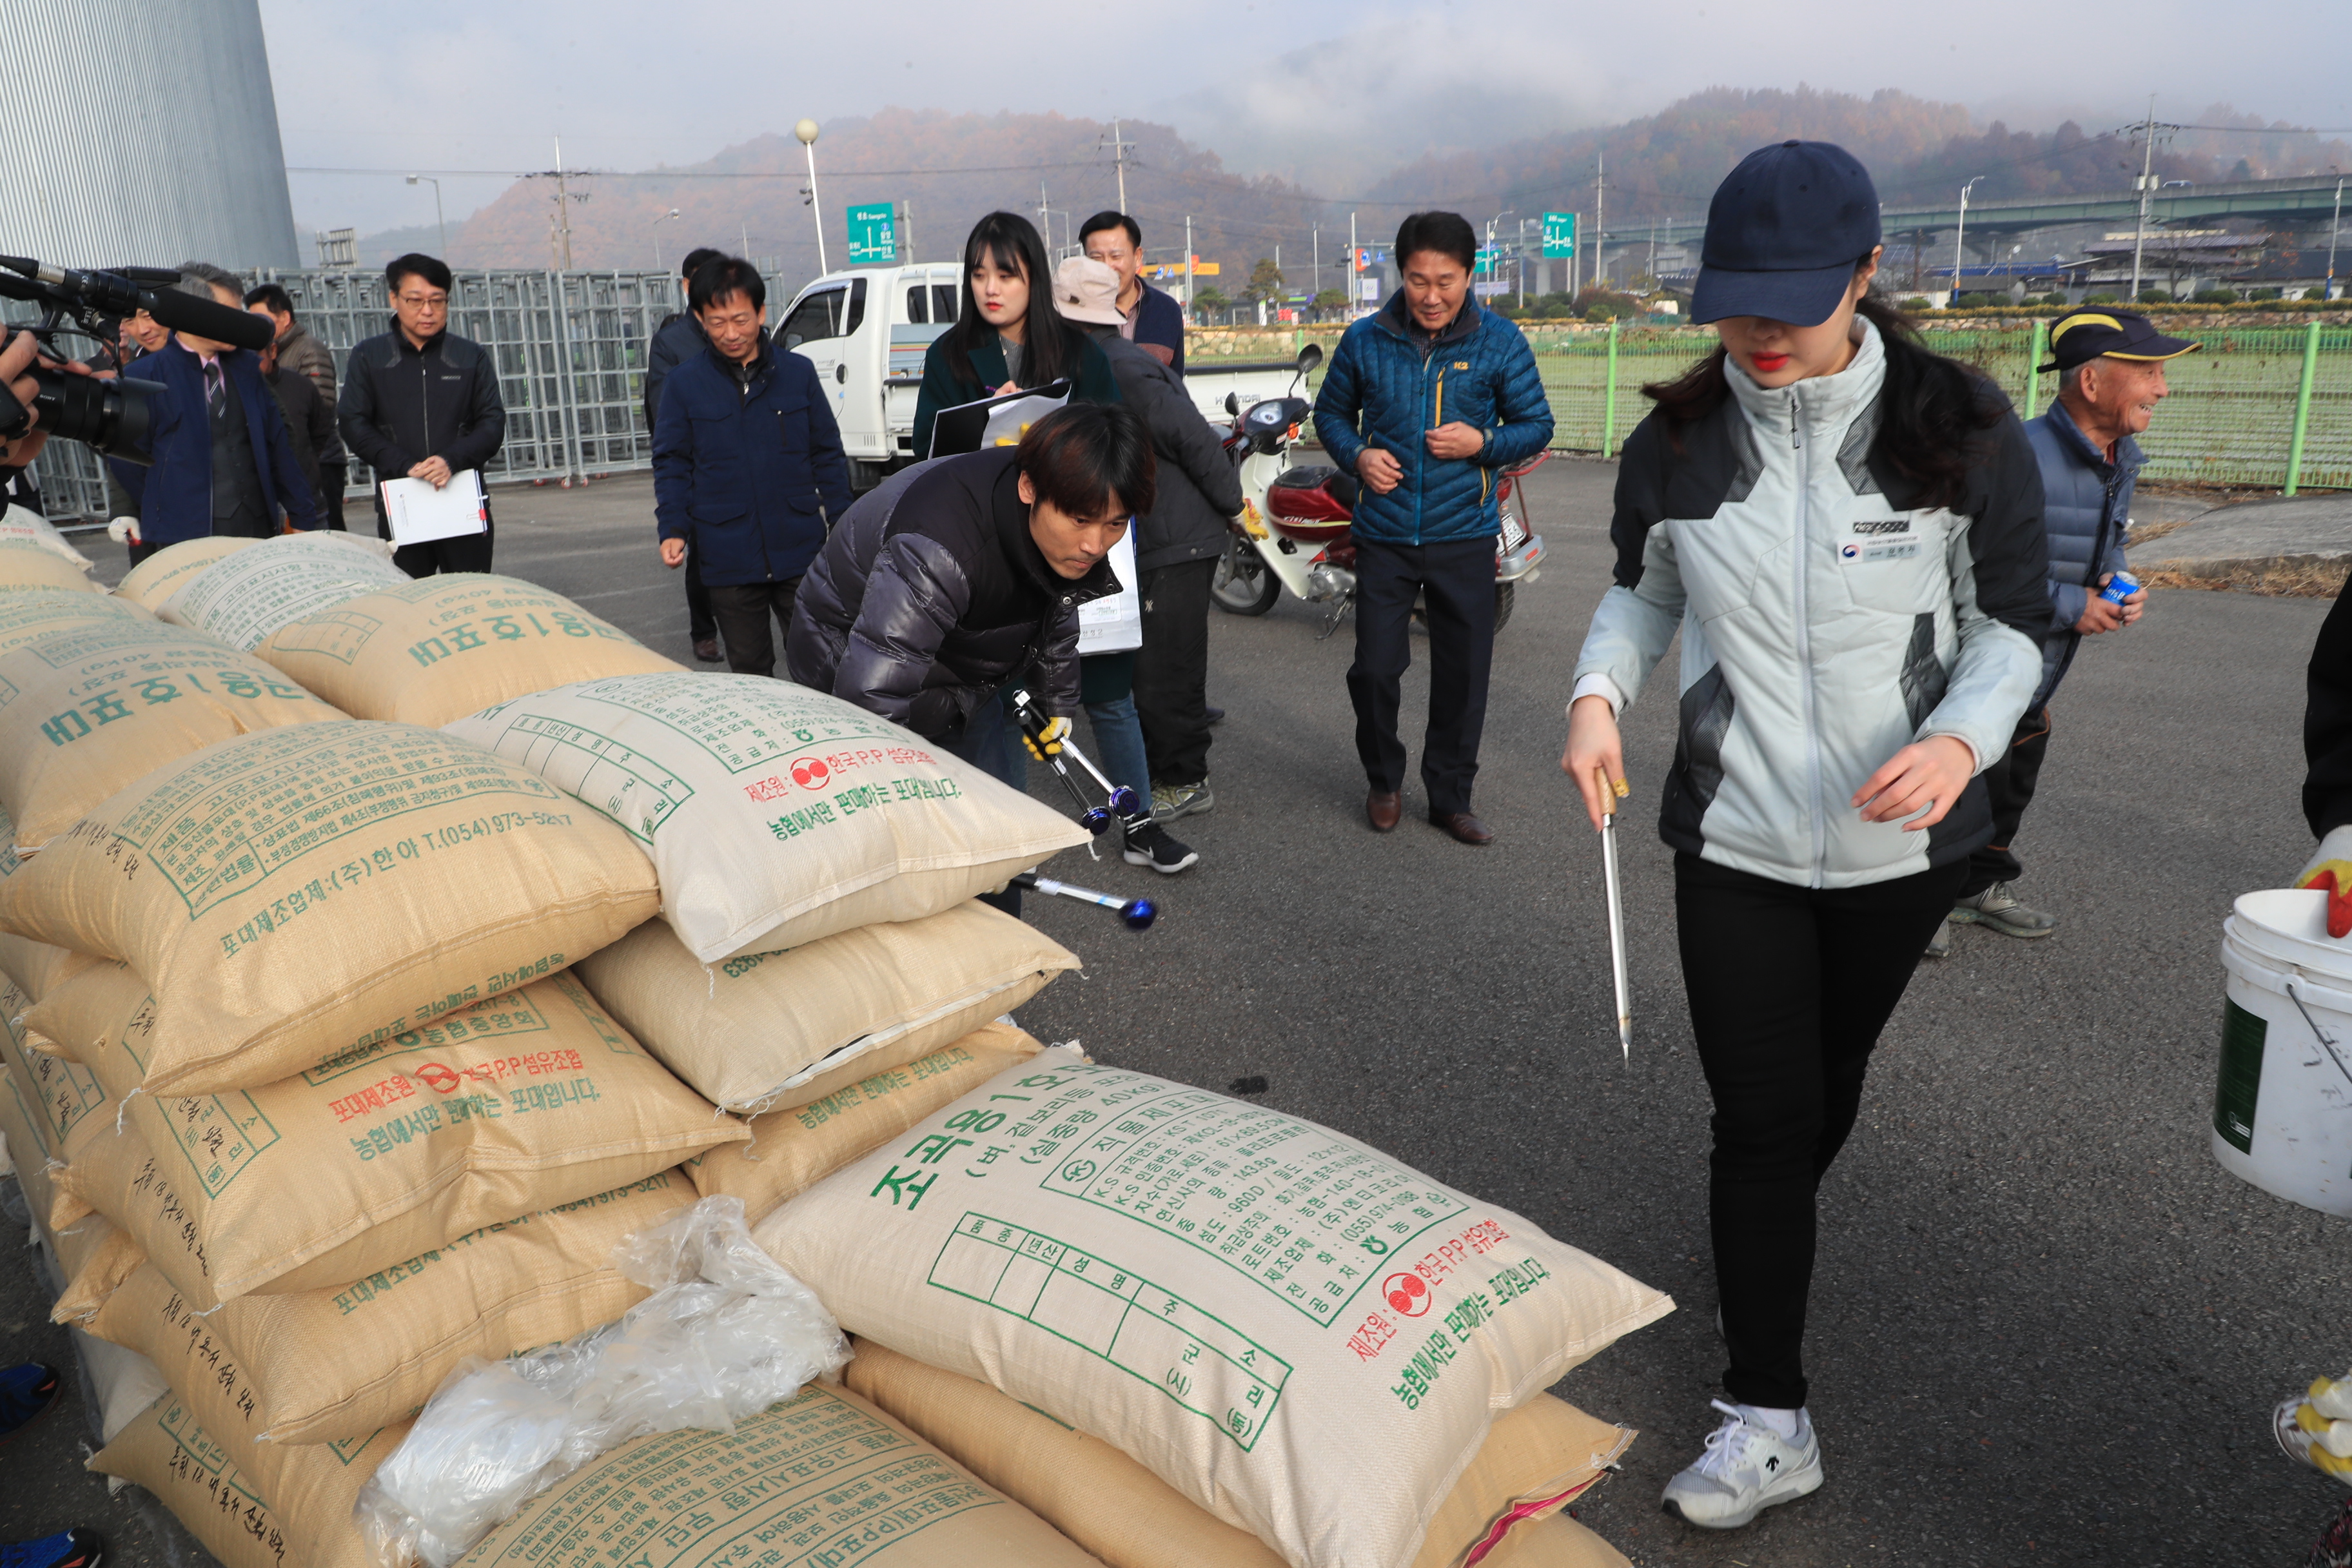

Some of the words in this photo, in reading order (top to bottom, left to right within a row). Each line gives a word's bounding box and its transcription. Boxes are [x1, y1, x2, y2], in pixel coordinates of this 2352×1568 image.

[1453, 361, 1469, 371] K2
[1215, 394, 1261, 406] HYNDAI
[407, 610, 623, 668] 곡용1호포대
[40, 672, 304, 749] 곡용1호포대
[205, 750, 336, 811] 고유표시사항
[423, 1011, 536, 1046] 농협중앙회
[350, 1106, 442, 1161] 농협에서만
[1391, 1330, 1456, 1410] 농협에서만
[721, 1447, 854, 1511] 고유표시사항
